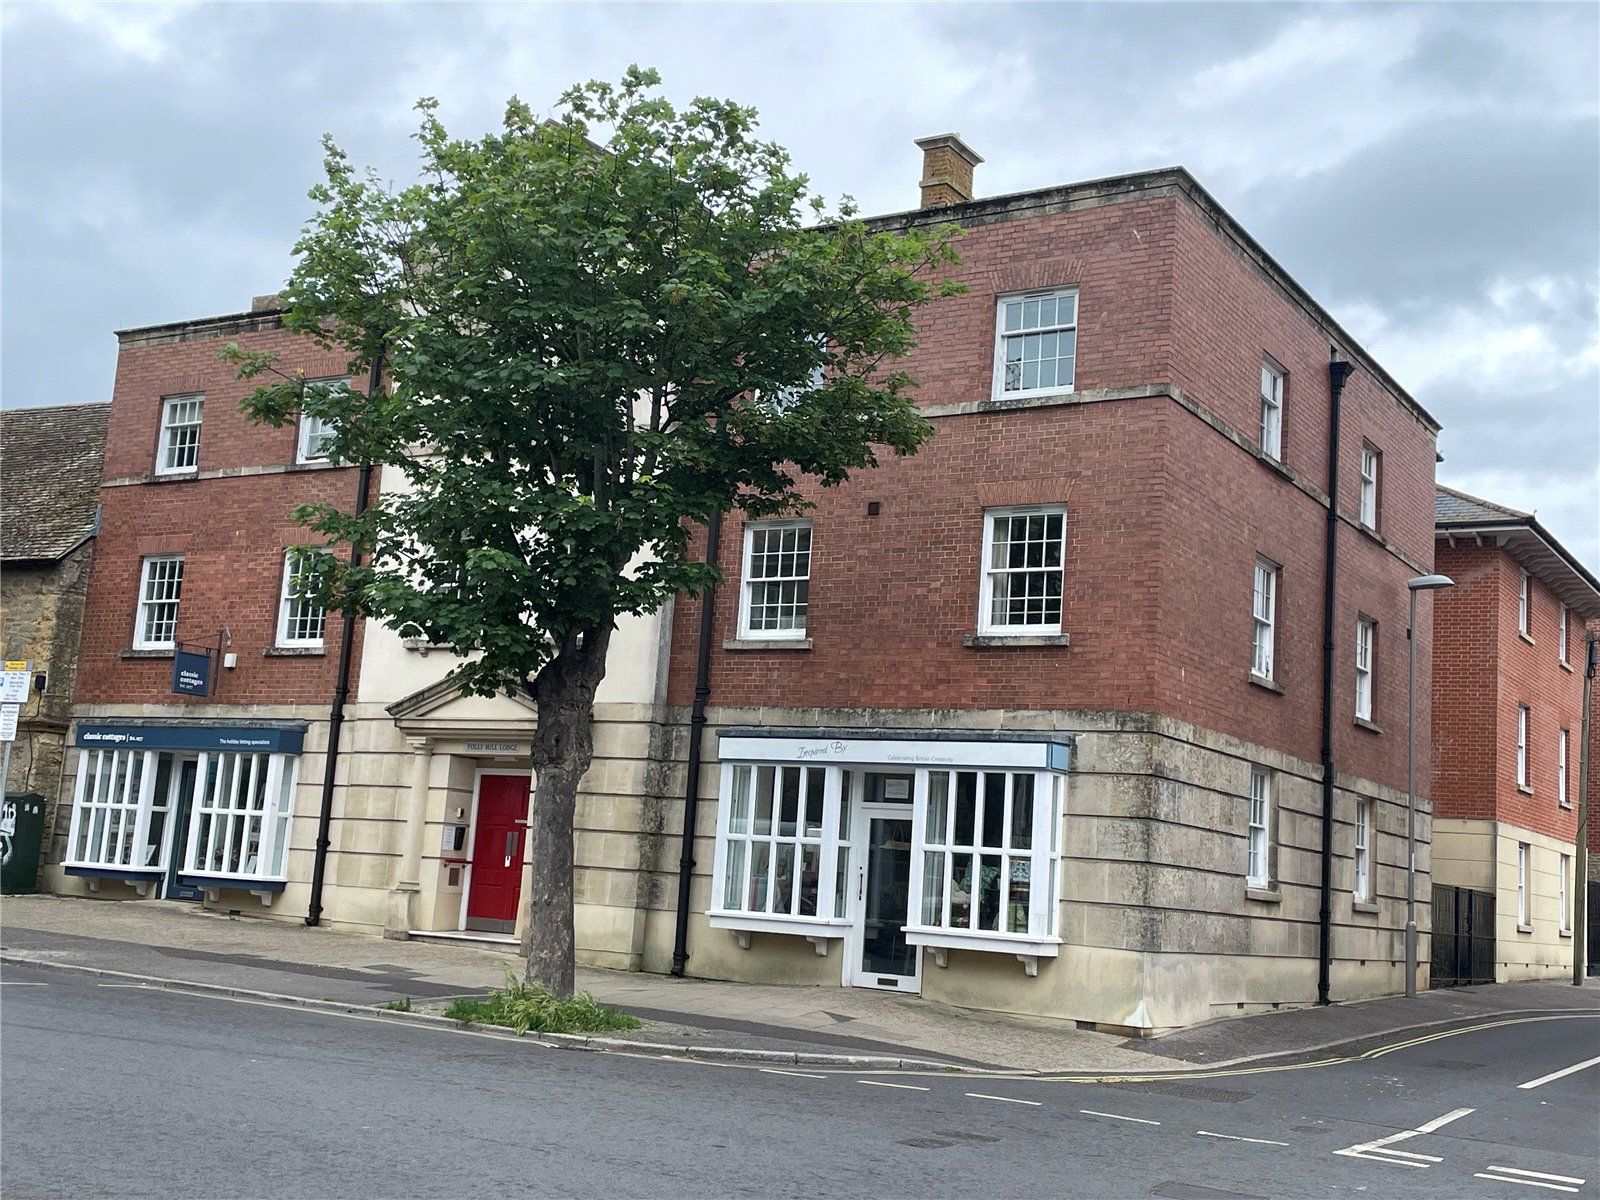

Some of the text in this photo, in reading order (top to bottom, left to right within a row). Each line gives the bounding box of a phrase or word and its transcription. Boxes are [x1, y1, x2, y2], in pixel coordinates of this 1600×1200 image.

[180, 670, 199, 678] classic
[180, 677, 203, 687] cottages
[83, 732, 102, 740] classic
[102, 733, 126, 743] cottages
[499, 743, 518, 751] LODGE
[797, 741, 848, 759] Inspired By
[887, 754, 915, 762] Celebrating
